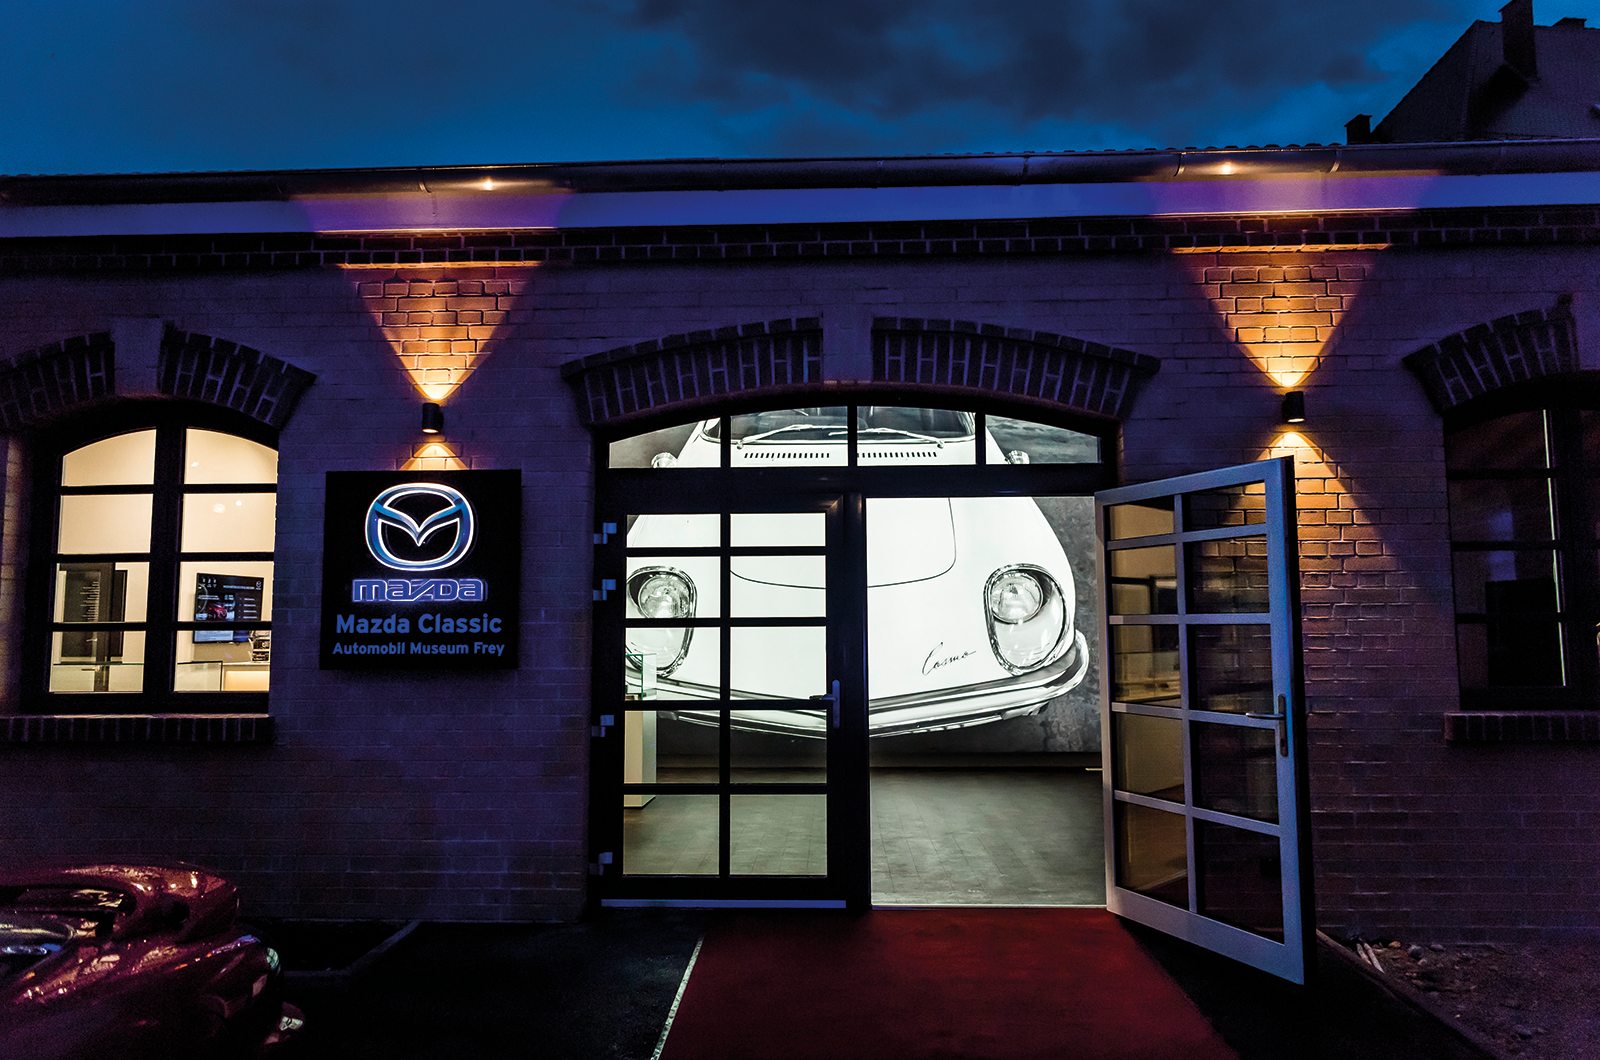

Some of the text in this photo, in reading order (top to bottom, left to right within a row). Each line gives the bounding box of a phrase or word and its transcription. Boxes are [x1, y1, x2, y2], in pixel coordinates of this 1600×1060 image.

[336, 613, 502, 634] Mazda Classic
[332, 641, 505, 657] Automobil Museum Frey
